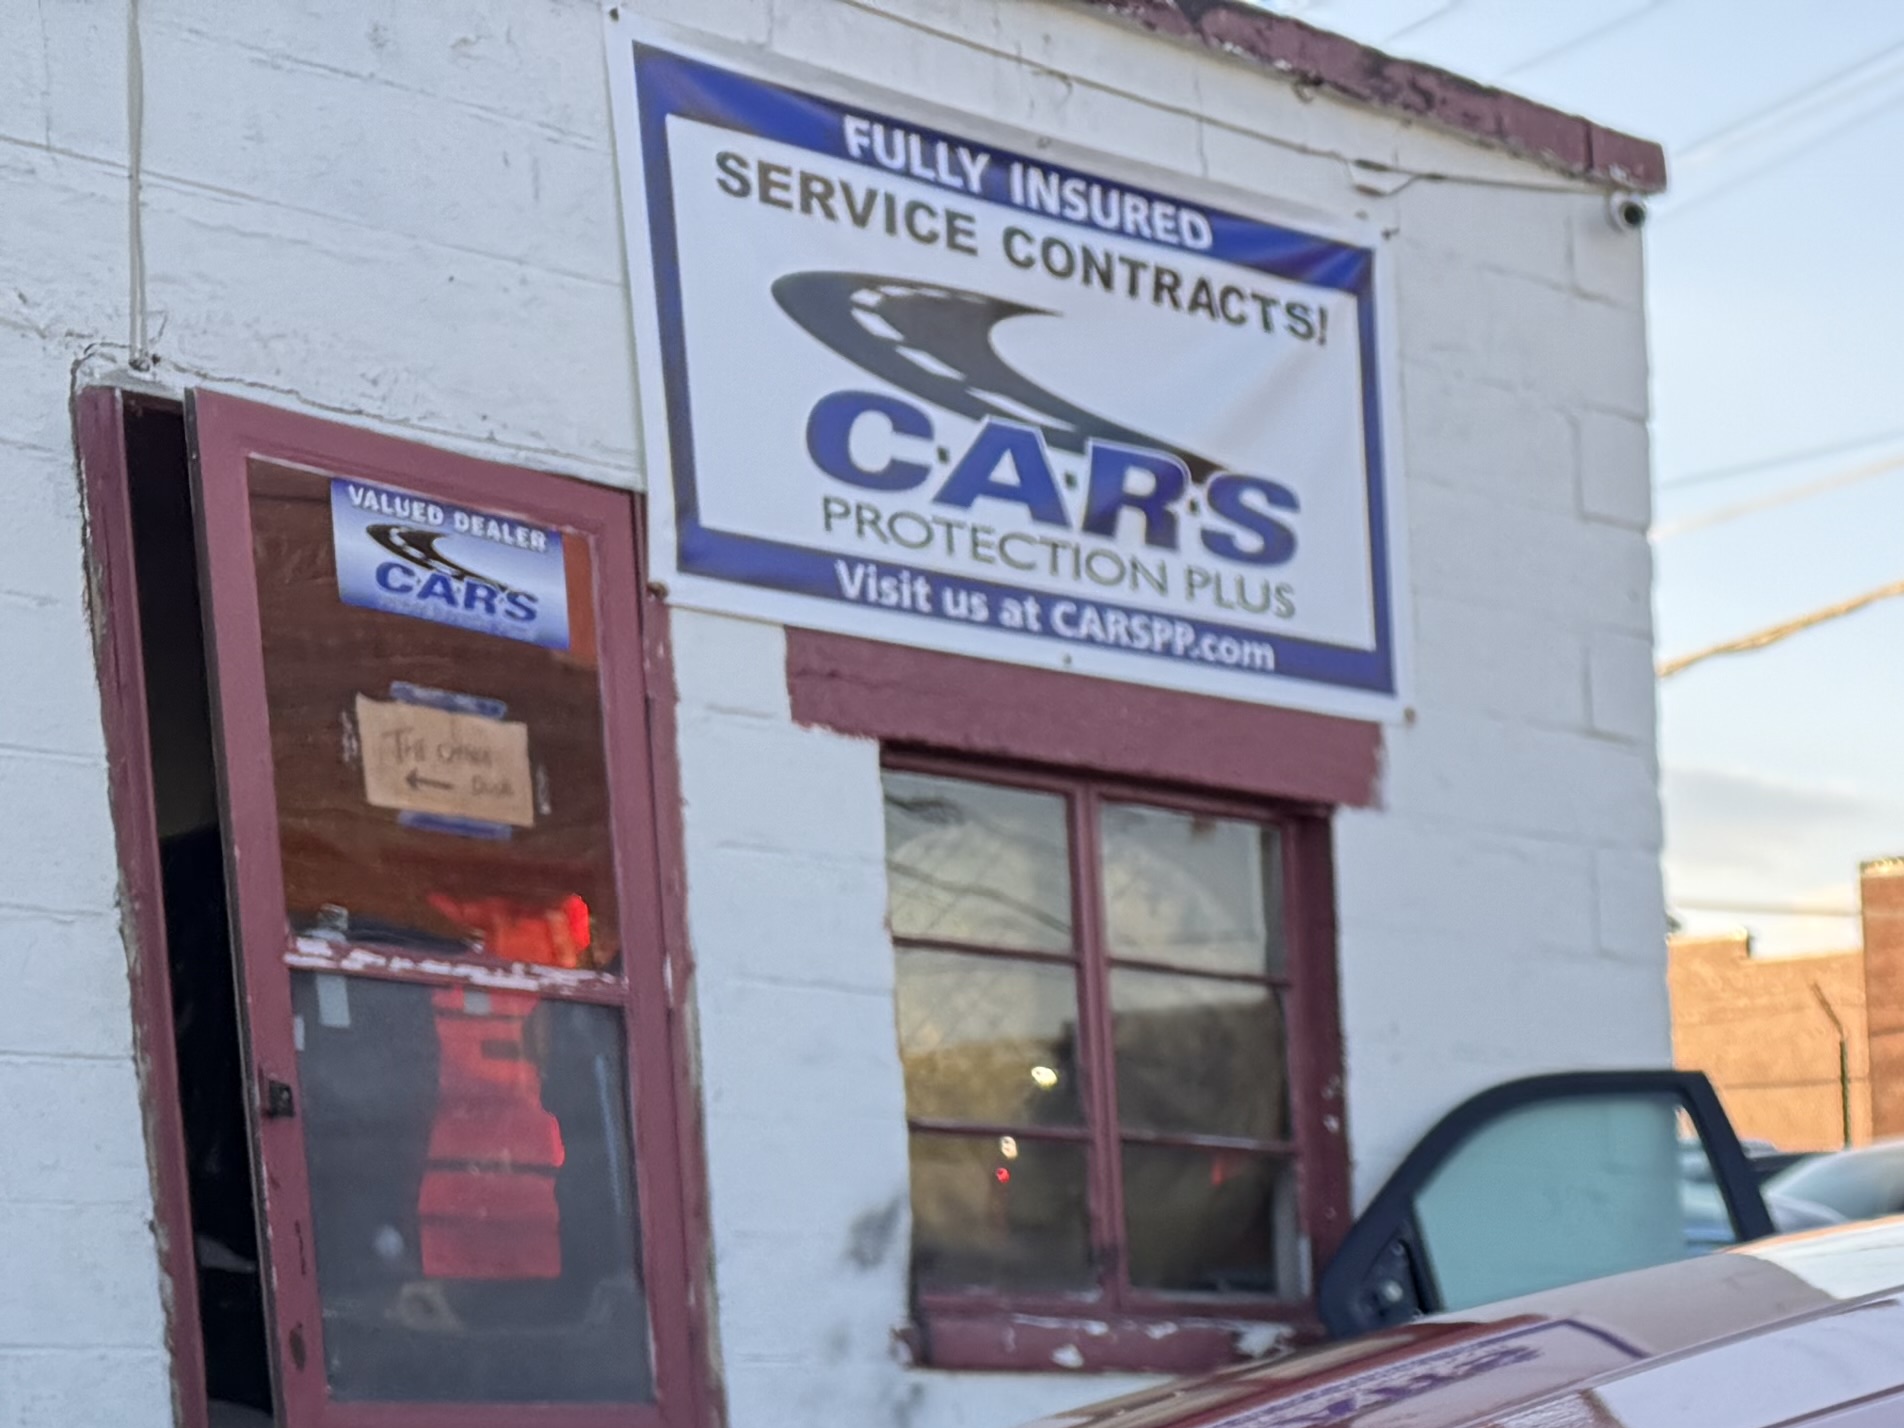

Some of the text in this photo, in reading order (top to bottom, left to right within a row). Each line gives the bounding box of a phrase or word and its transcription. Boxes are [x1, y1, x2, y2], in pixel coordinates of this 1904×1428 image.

[843, 115, 1213, 251] FULLY INSURED
[714, 150, 1328, 347] SERVICE CONTRACTS!
[348, 484, 547, 552] VALUED DEALER
[822, 495, 1297, 620] PROTECTION PLUS
[835, 558, 1275, 671] Visit us at CARSPP.com
